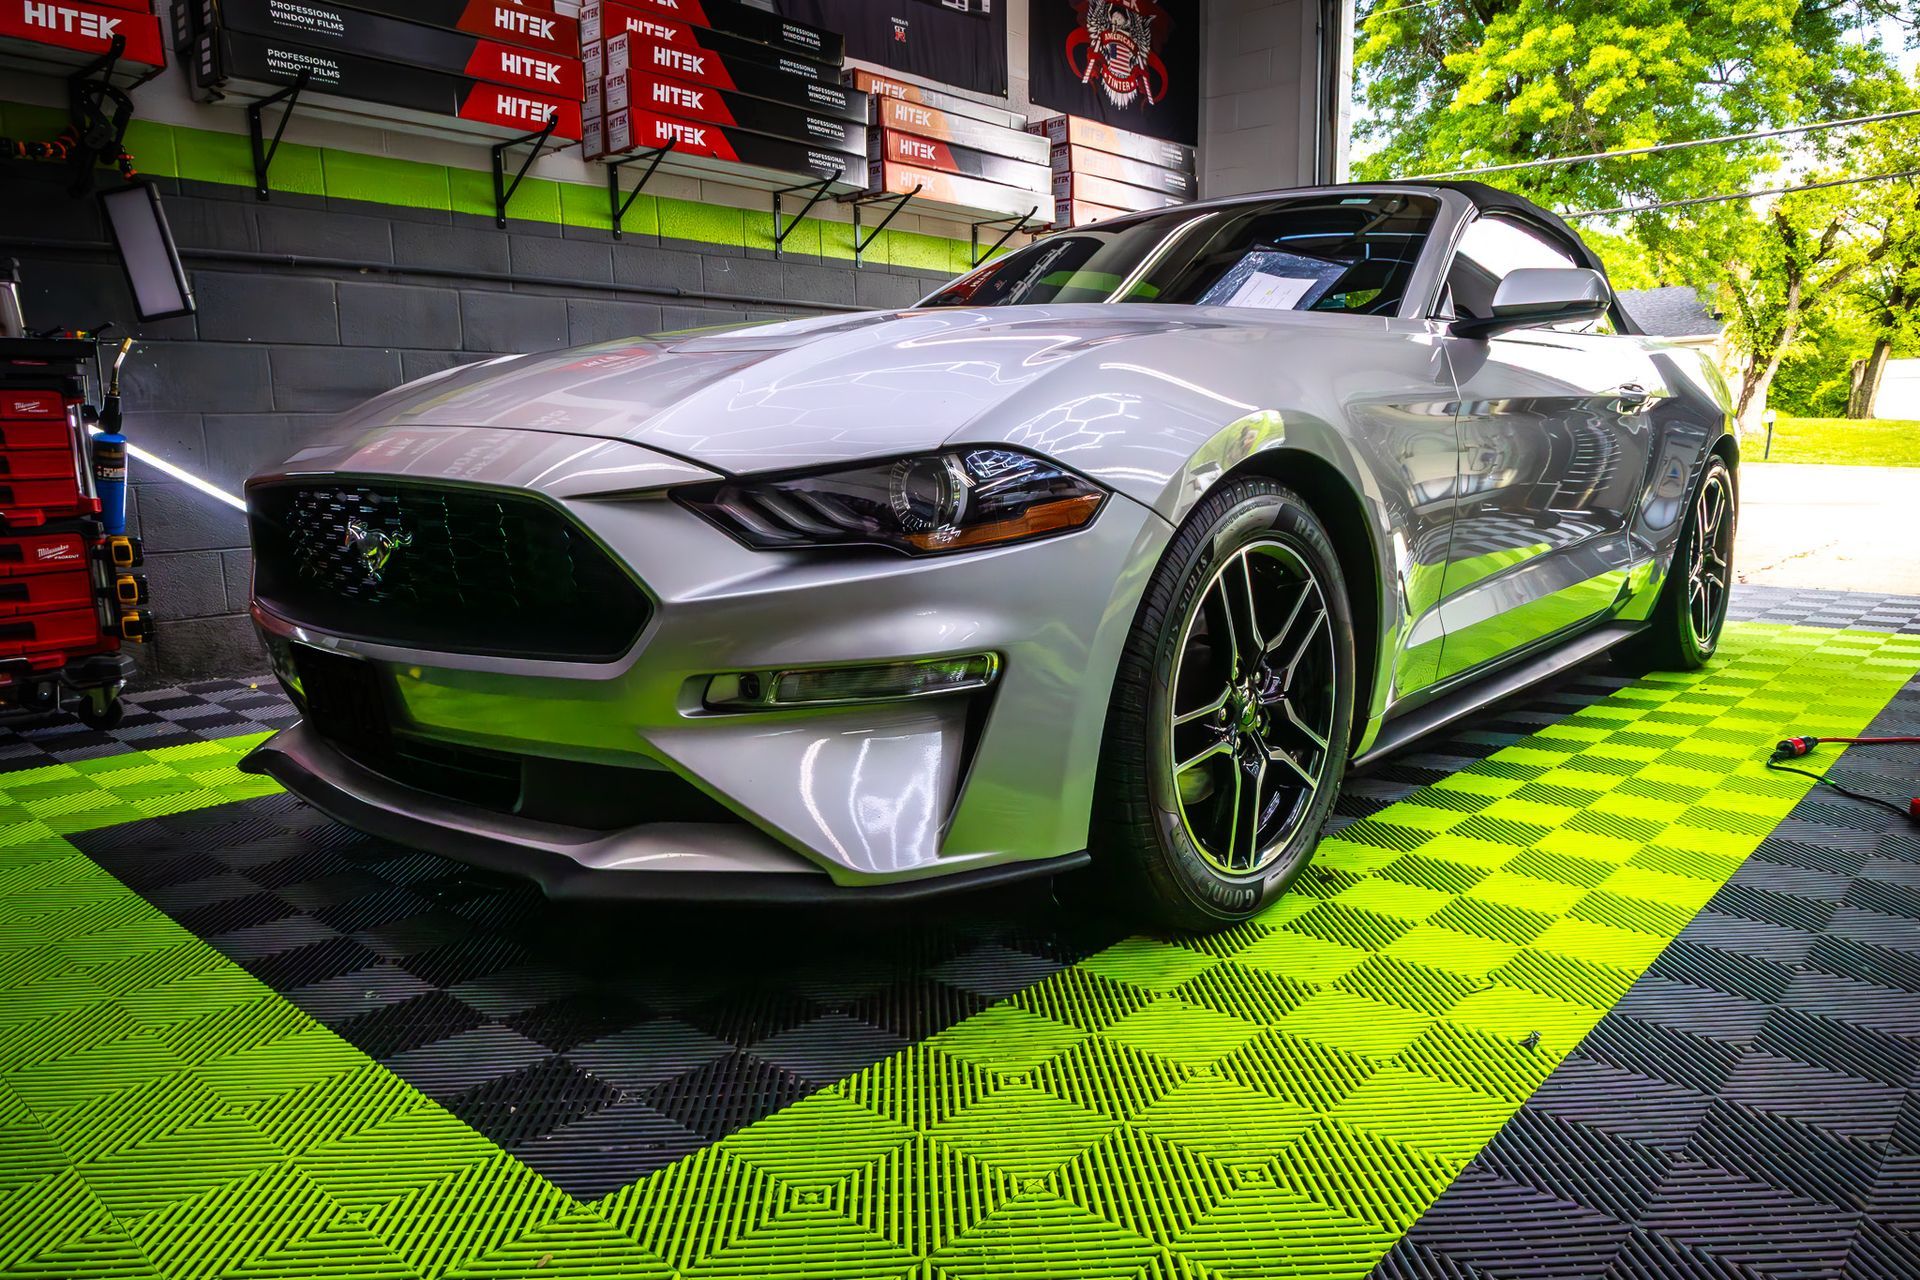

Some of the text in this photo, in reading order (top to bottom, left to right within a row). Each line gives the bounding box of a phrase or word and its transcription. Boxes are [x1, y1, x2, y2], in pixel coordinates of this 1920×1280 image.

[270, 0, 342, 21] PROFESSIONAL
[581, 6, 599, 20] HITEK
[24, 0, 122, 40] HITEK
[270, 9, 344, 31] WINDOW FILMS
[495, 7, 556, 41] HITEK
[626, 17, 678, 41] HITEK
[782, 30, 806, 42] WINDOW
[806, 37, 821, 47] FILMS
[783, 23, 820, 40] PROFESSIONAL
[608, 39, 626, 55] HITEK
[1104, 32, 1135, 51] AMERICAN
[267, 48, 338, 69] PROFESSIONAL
[653, 46, 704, 75] HITEK
[780, 58, 817, 74] PROFESSIONAL
[313, 66, 340, 79] FILMS
[501, 52, 561, 84] HITEK
[587, 83, 599, 96] TEK
[607, 74, 625, 89] HITEK
[871, 79, 908, 100] HITEK
[1107, 74, 1131, 92] TINTER
[653, 83, 704, 110] HITEK
[807, 84, 845, 100] PROFESSIONAL
[807, 91, 832, 103] WINDOW
[831, 97, 846, 106] FILMS
[497, 94, 558, 123] HITEK
[895, 104, 932, 127] HITEK
[608, 114, 627, 131] HITEK
[806, 117, 844, 132] PROFESSIONAL
[807, 124, 830, 135] WINDOW
[830, 129, 845, 139] FILMS
[656, 121, 706, 147] HITEK
[807, 151, 845, 165] PROFESSIONAL
[900, 138, 936, 161] HITEK
[808, 158, 832, 168] WINDOW
[831, 162, 846, 171] FILMS
[901, 170, 935, 192] HITEK
